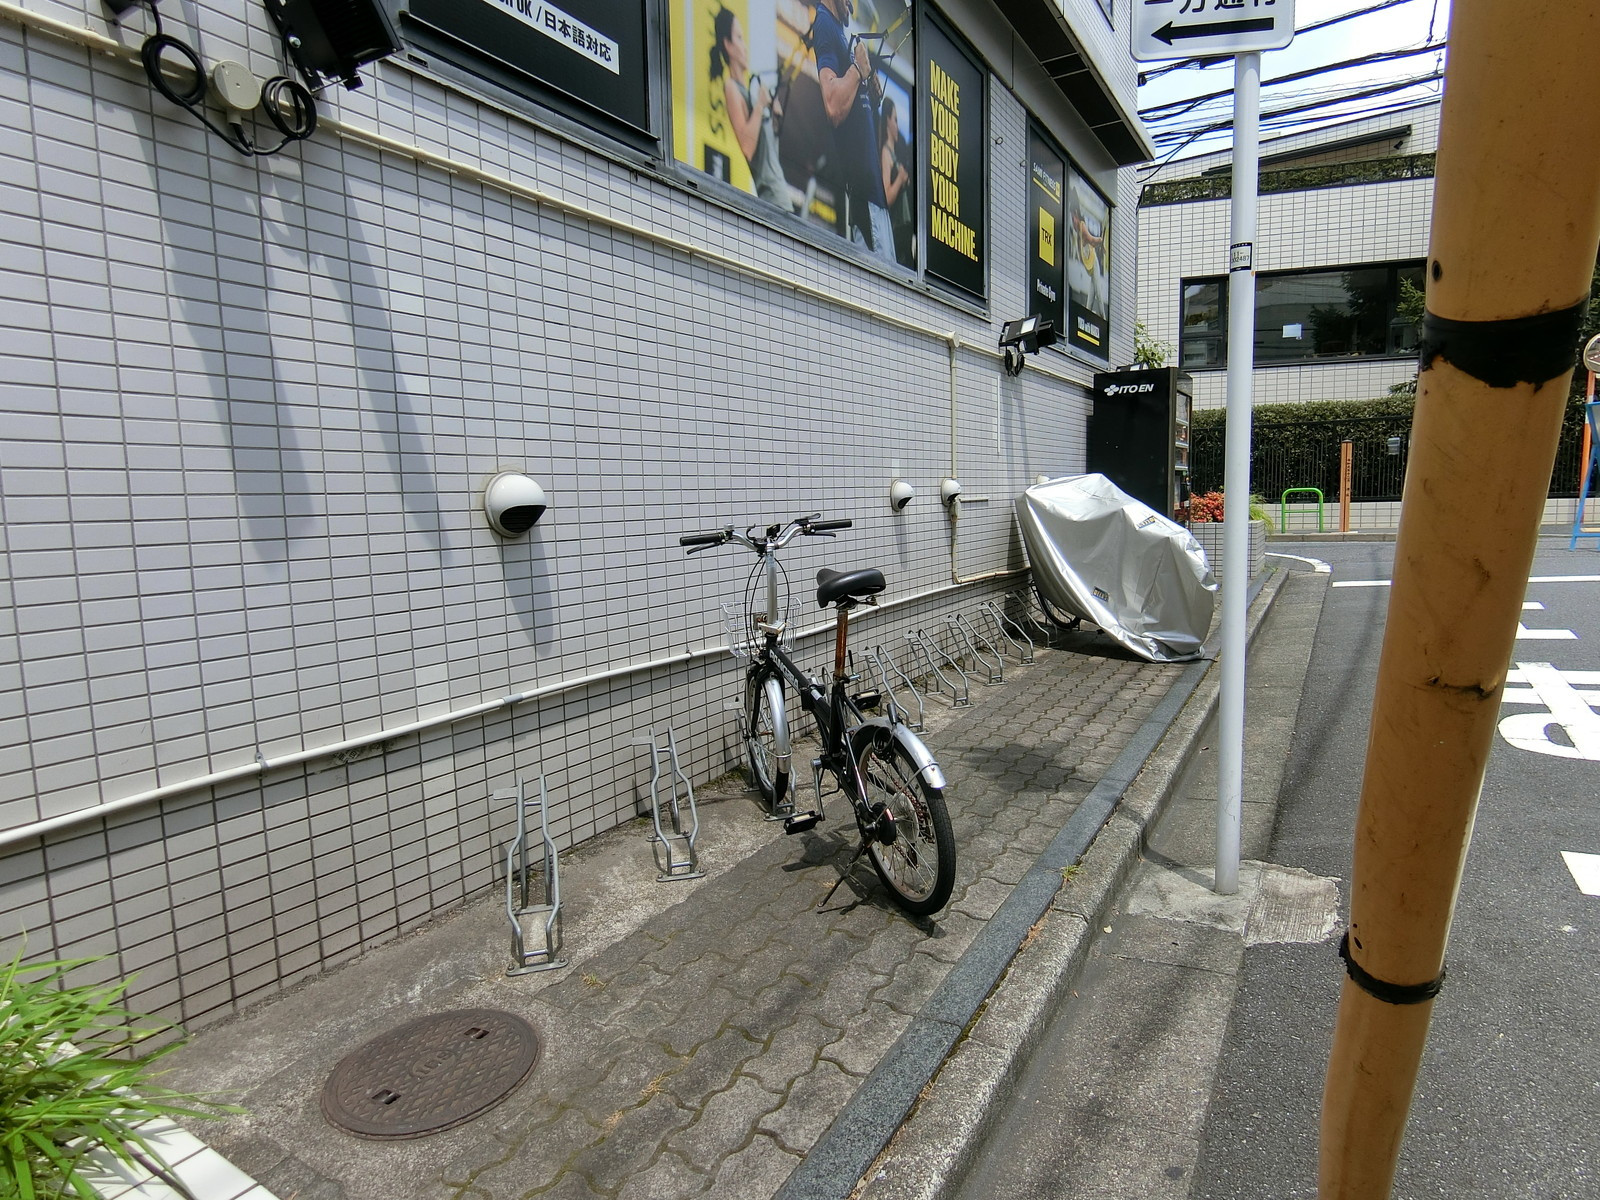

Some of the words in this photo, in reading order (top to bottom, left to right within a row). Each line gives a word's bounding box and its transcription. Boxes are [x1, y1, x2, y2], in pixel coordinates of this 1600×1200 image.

[544, 9, 612, 62] 日本語対応
[930, 59, 960, 117] MAKE
[930, 95, 959, 150] YOUR
[930, 132, 959, 183] BODY
[930, 168, 960, 218] YOUR
[931, 204, 979, 262] MACHINE.
[1041, 227, 1053, 246] TRX
[1118, 384, 1139, 395] ITO
[1138, 383, 1155, 393] EN
